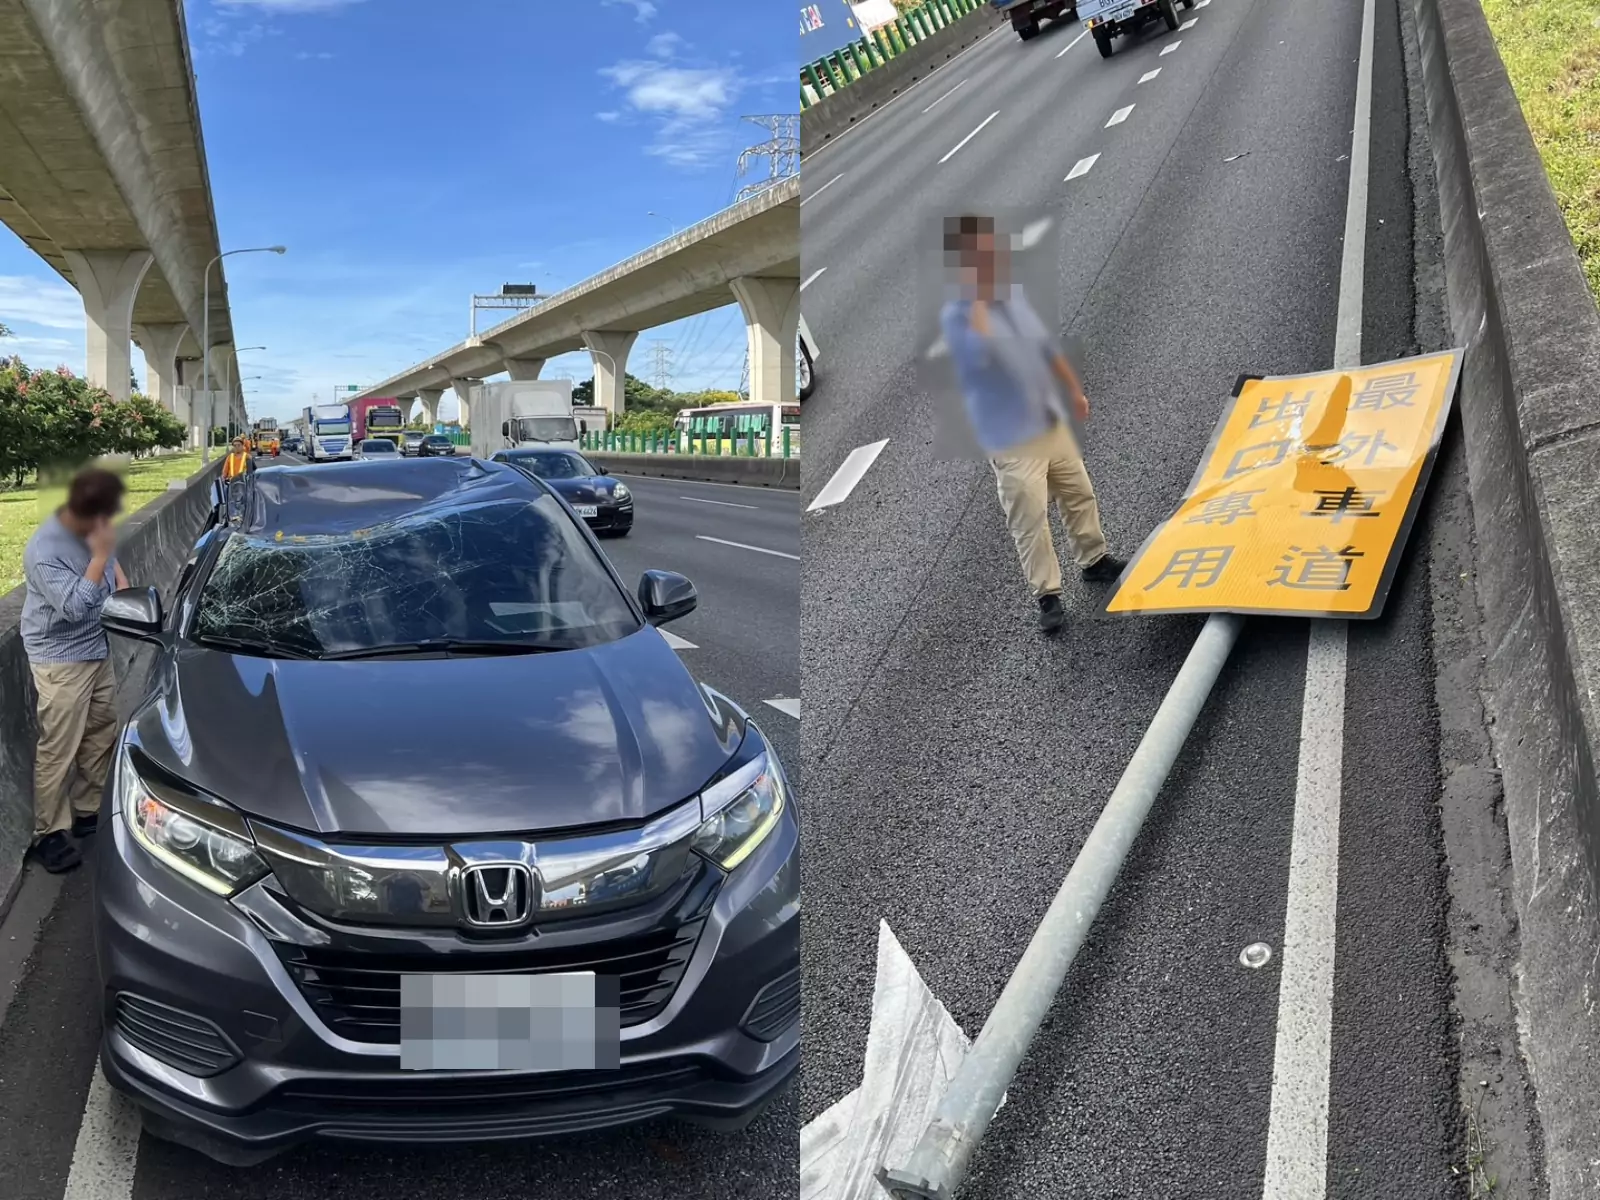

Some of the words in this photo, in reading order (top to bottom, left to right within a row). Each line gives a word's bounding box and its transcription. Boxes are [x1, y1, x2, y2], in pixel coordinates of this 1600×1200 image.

[1143, 391, 1314, 591] 出口專用
[1267, 372, 1421, 591] 最外車道
